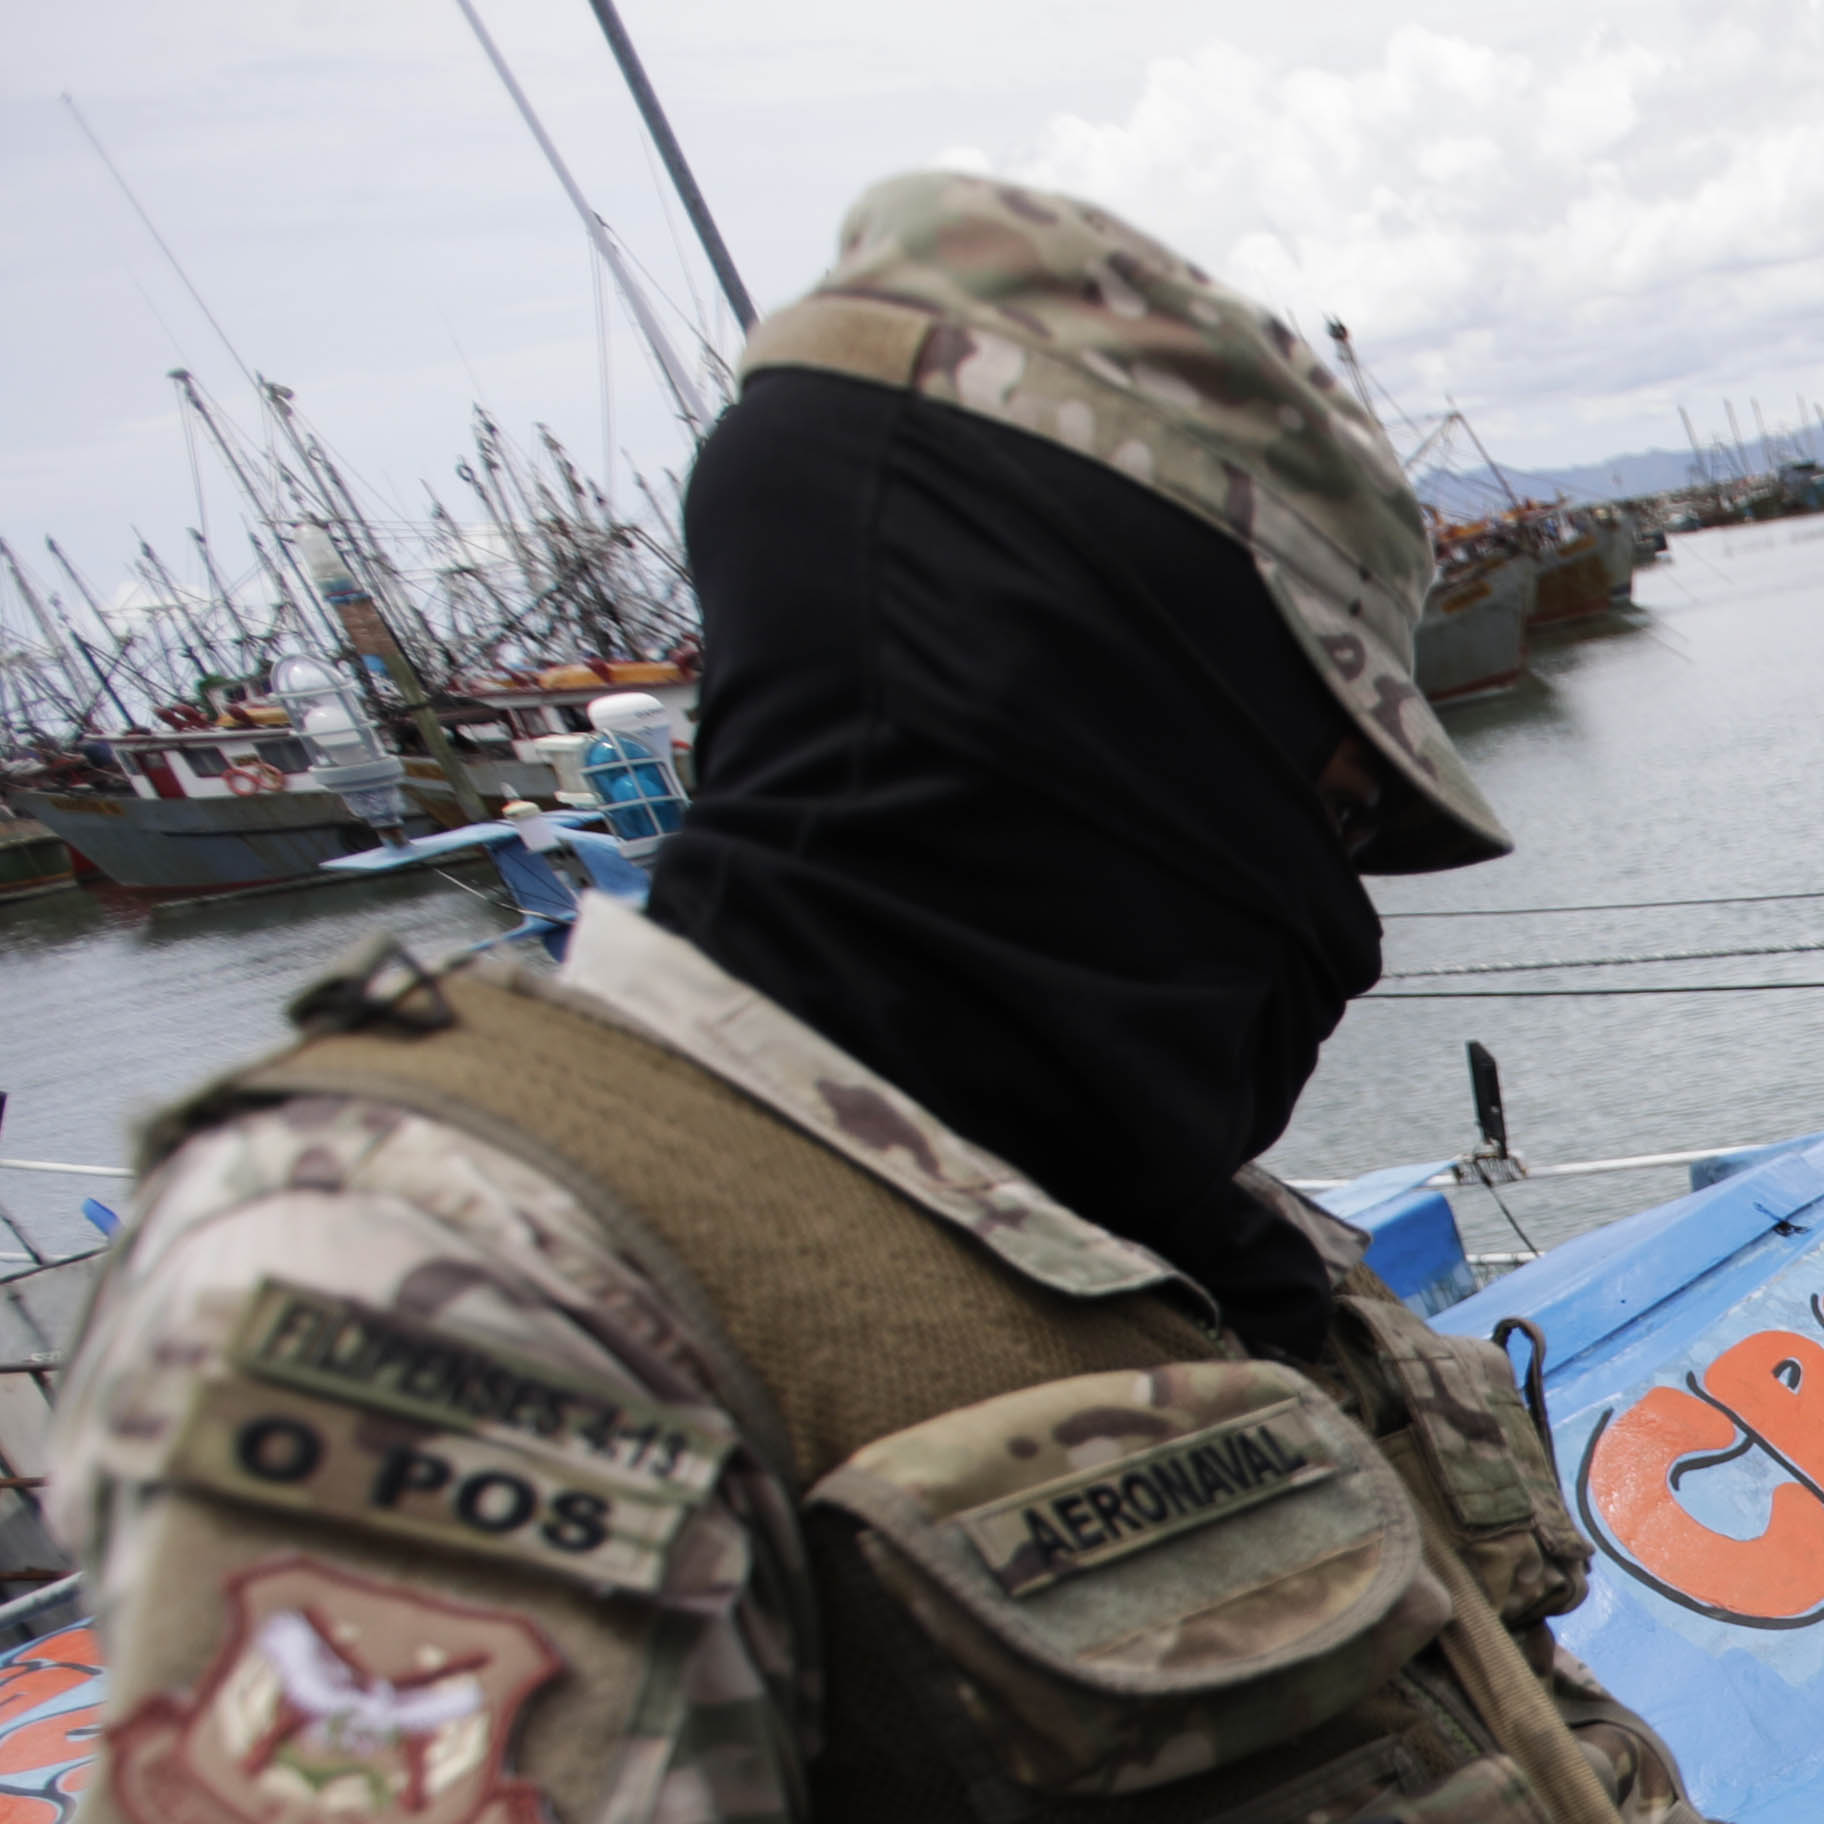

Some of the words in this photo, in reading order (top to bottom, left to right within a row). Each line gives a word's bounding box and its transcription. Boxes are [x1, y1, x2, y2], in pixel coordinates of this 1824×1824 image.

[236, 1416, 325, 1484] O
[370, 1446, 613, 1554] POS
[1022, 1425, 1307, 1561] AERONAVAL
